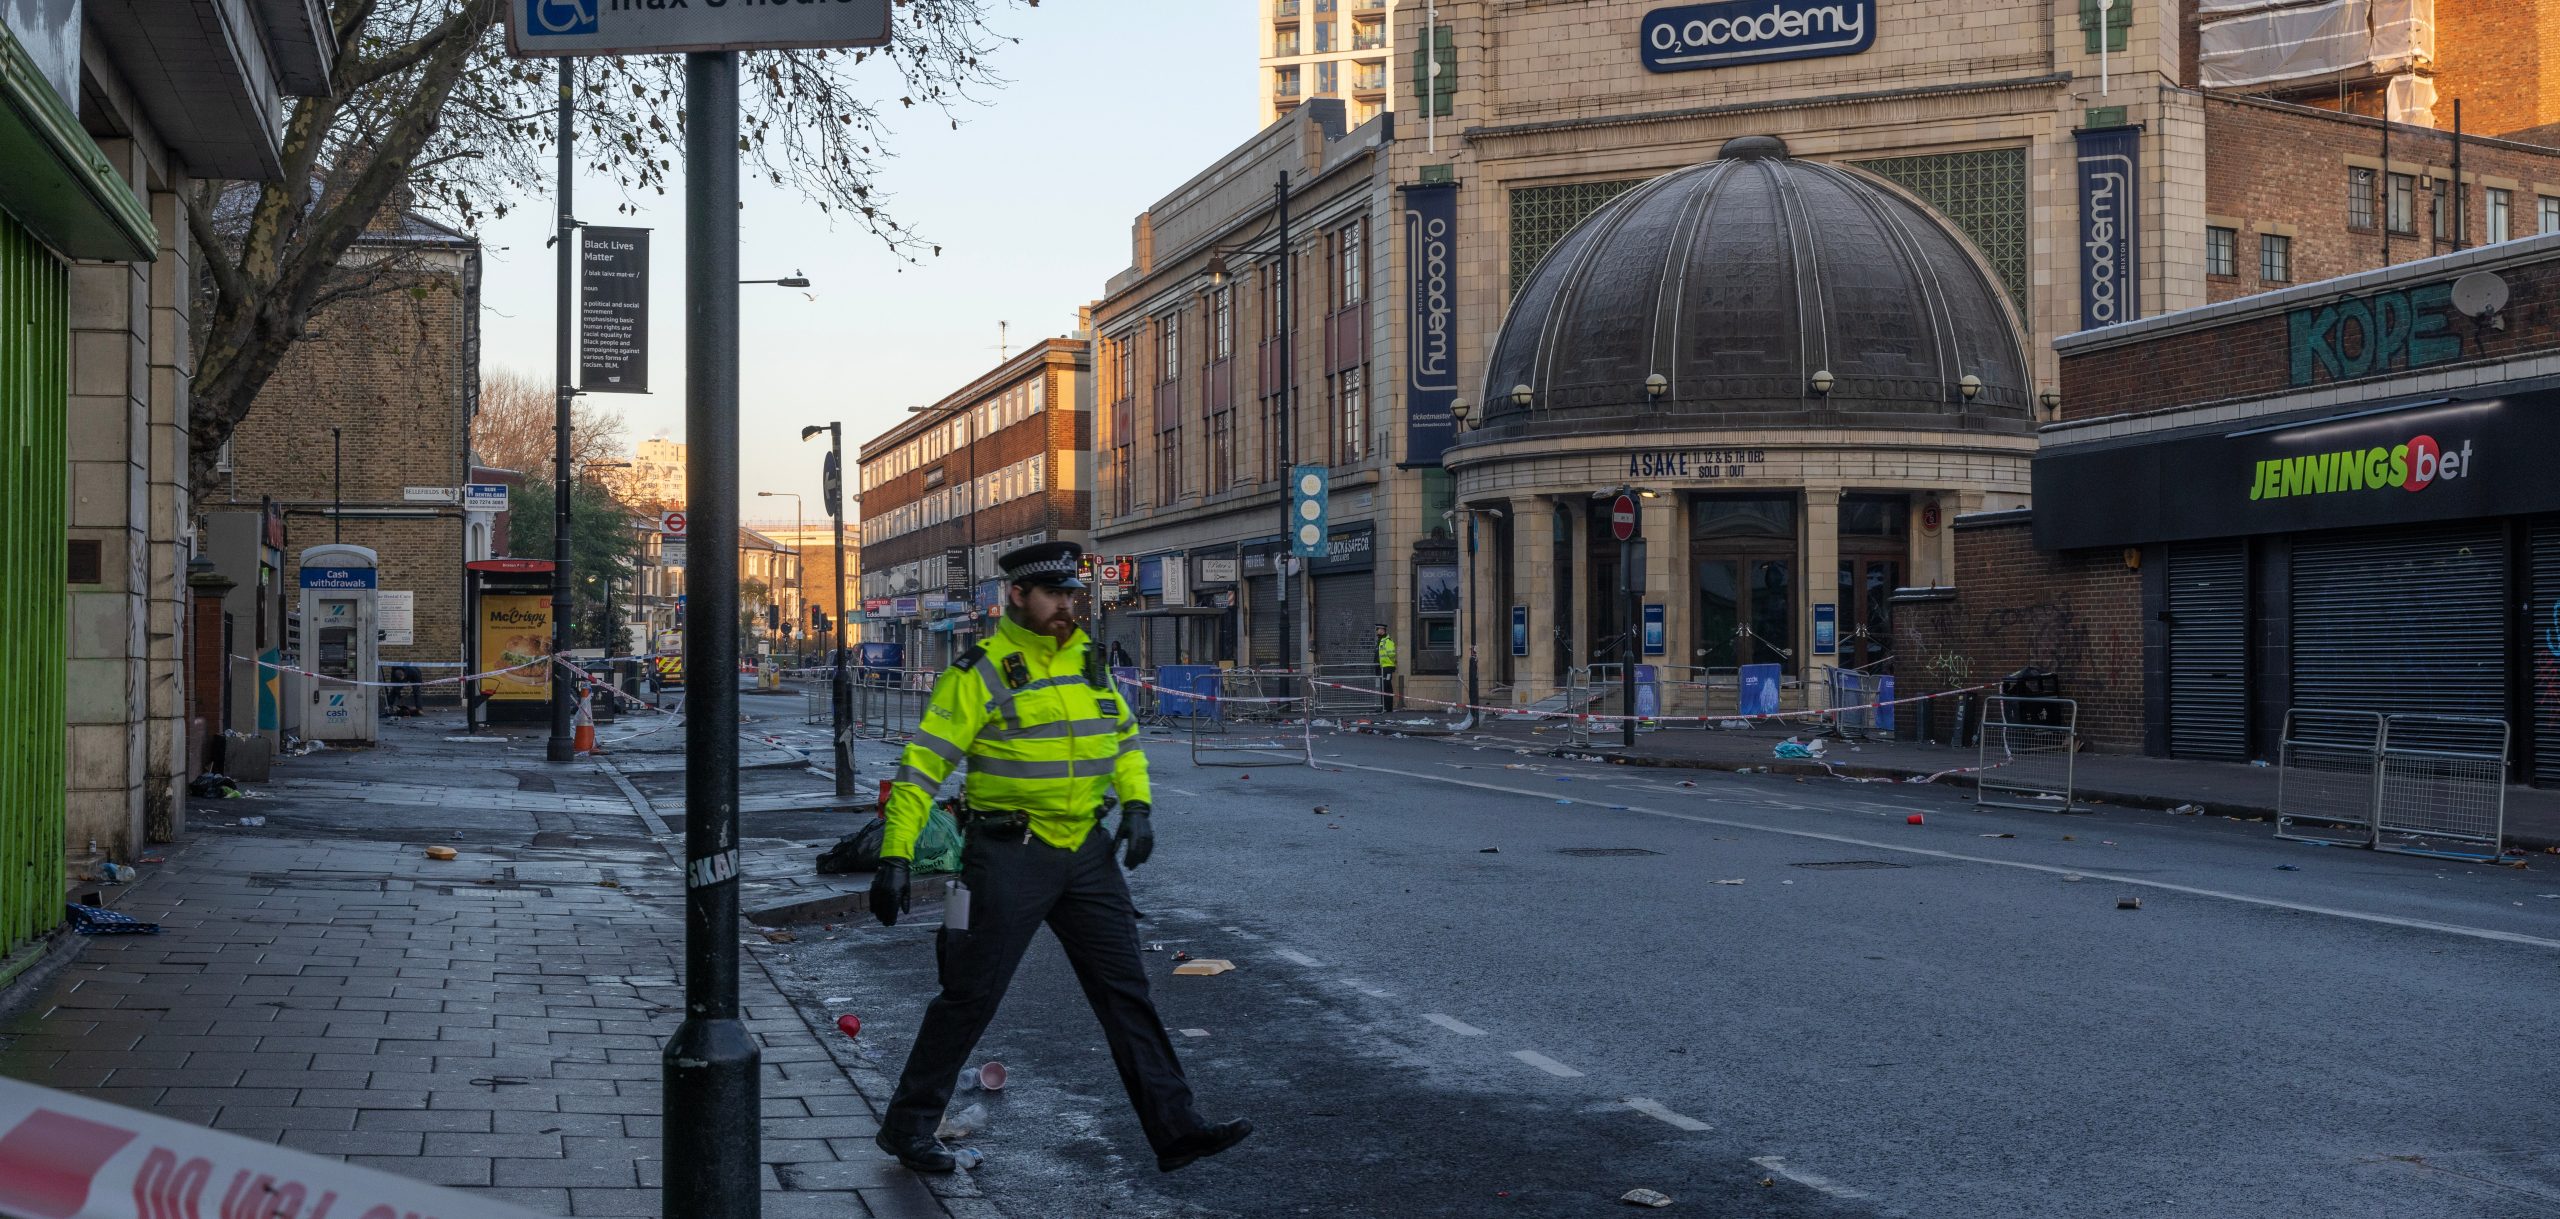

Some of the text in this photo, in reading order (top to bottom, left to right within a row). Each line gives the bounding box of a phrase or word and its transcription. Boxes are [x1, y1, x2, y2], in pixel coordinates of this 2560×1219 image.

[1683, 3, 1864, 46] academy
[584, 240, 634, 251] Black Lives
[2086, 172, 2115, 322] academy
[584, 252, 614, 261] Matter
[1424, 242, 1451, 376] academy
[583, 316, 619, 324] emphasising
[2287, 282, 2464, 388] KOPE
[583, 347, 619, 355] campaigning
[1412, 413, 1451, 421] ticketmaster
[1629, 452, 1688, 477] ASAKE
[1704, 451, 1713, 463] 12
[1715, 451, 1722, 463] &
[1724, 451, 1733, 464] 15
[1747, 450, 1765, 463] DEC
[1698, 464, 1746, 478] SOLD OUT
[326, 570, 349, 579] Cash
[1422, 570, 1437, 578] box
[309, 578, 366, 588] withdrawals
[490, 607, 547, 628] McCrispy
[326, 708, 348, 717] cash
